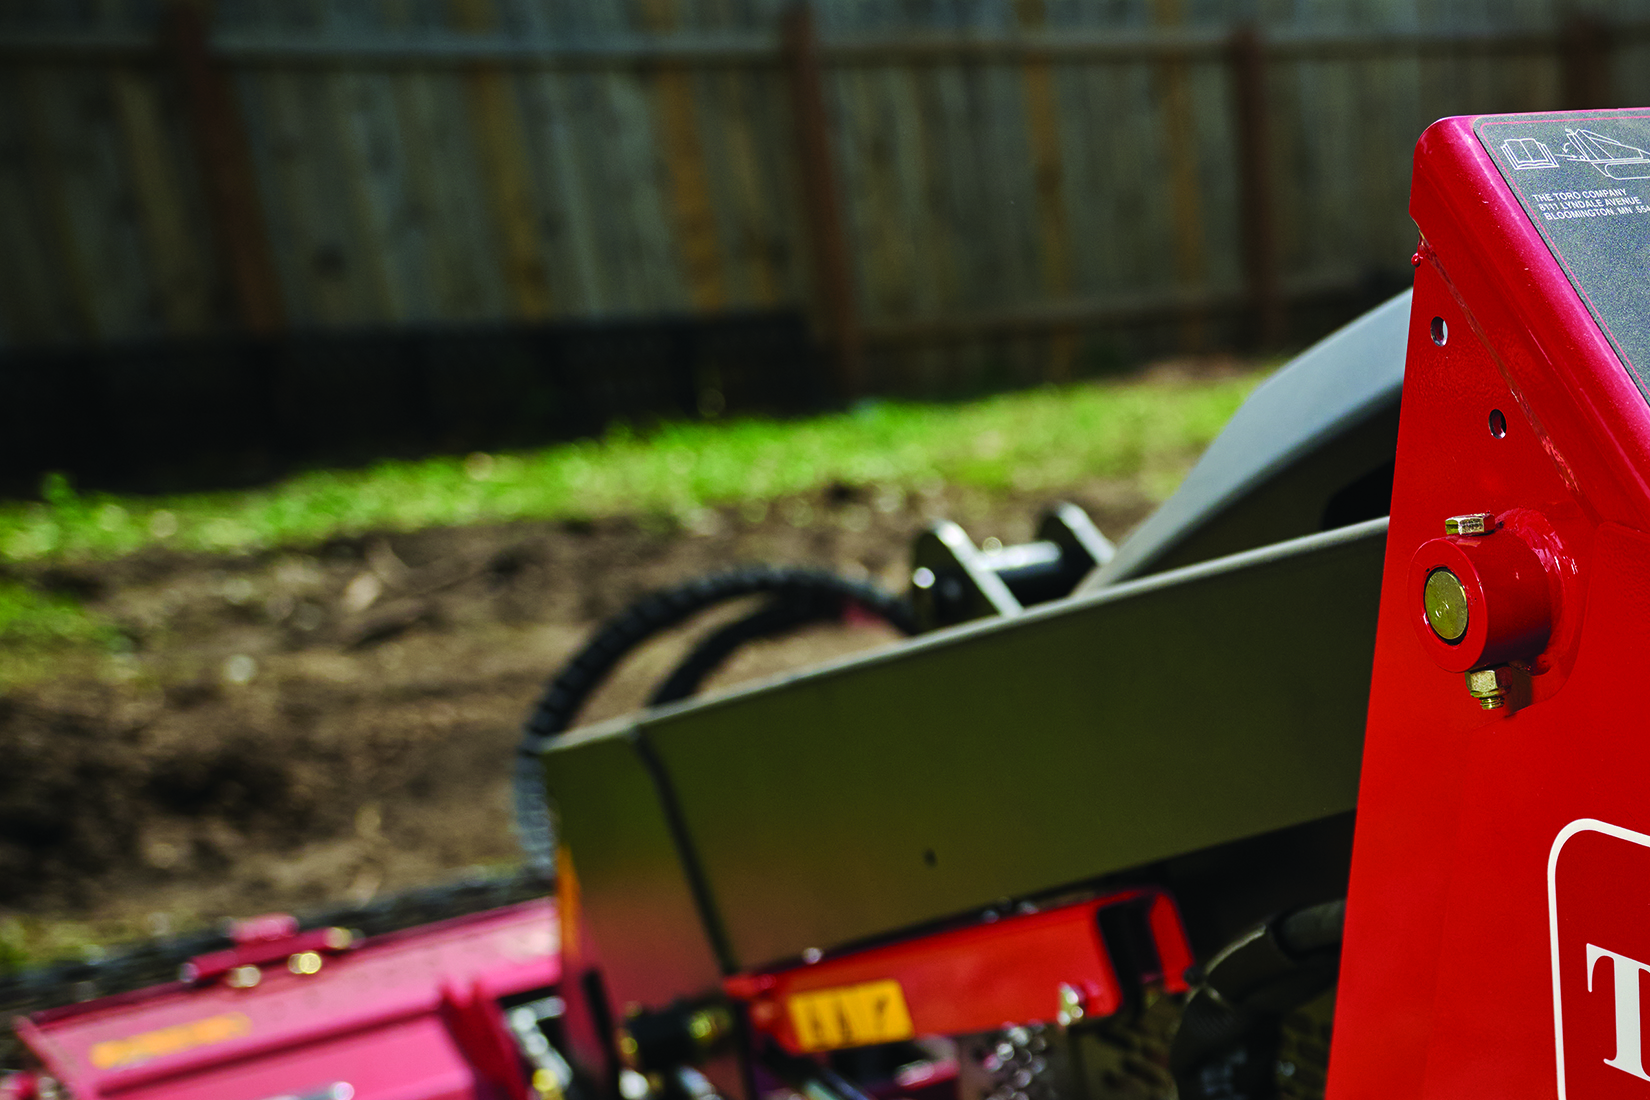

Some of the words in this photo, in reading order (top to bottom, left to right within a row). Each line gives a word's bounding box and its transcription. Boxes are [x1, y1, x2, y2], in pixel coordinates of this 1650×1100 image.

[1532, 193, 1554, 202] THE
[1553, 191, 1581, 200] TORO
[1582, 188, 1627, 198] COMPANY
[1538, 203, 1559, 211] 8111
[1559, 199, 1604, 210] LYNDALE
[1604, 196, 1642, 206] AVENUE
[1616, 206, 1634, 215] MN
